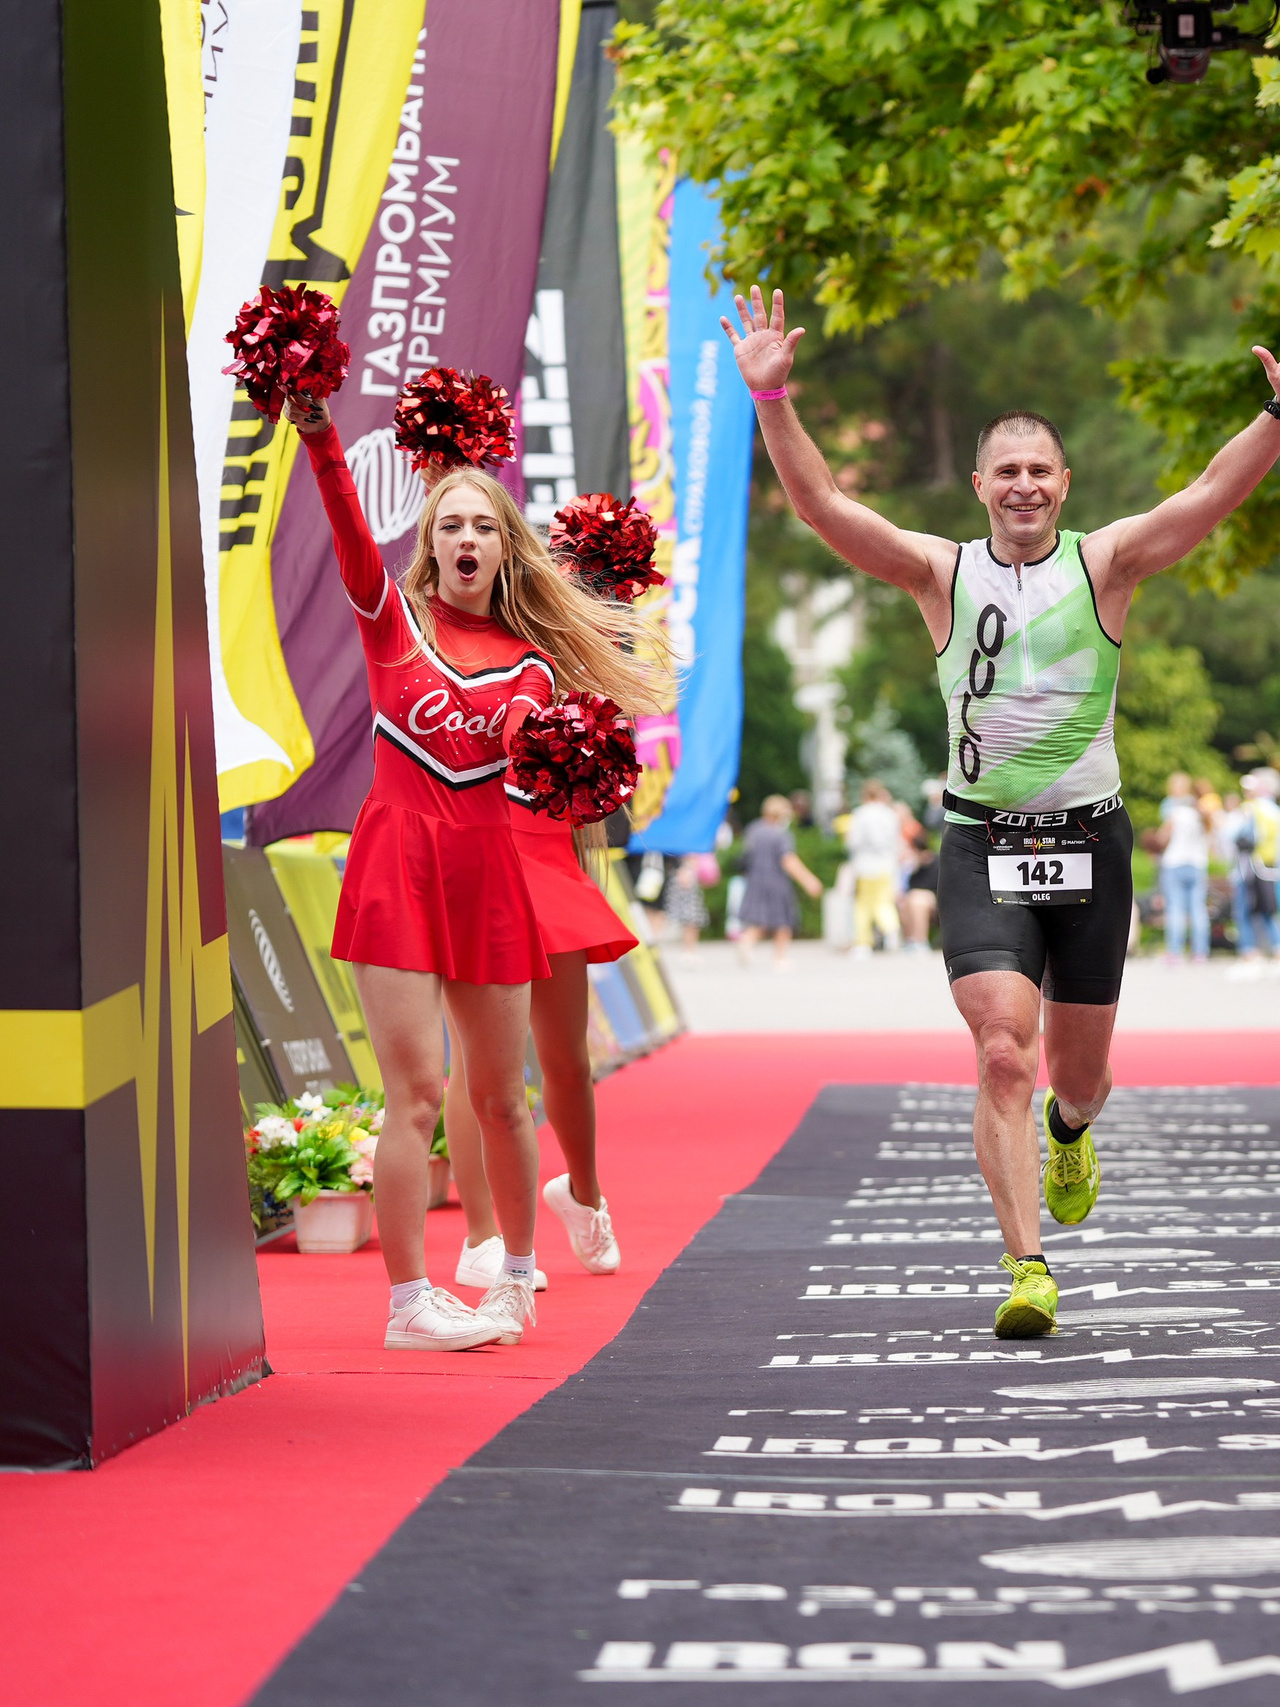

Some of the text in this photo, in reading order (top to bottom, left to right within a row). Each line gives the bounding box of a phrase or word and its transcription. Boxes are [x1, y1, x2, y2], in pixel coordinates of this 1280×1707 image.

[958, 603, 1008, 785] orca
[408, 689, 508, 738] Cool
[992, 809, 1068, 828] ZONE3
[1016, 860, 1064, 886] 142
[1031, 893, 1051, 901] OLEG
[768, 1350, 1042, 1366] IRON
[712, 1434, 1041, 1454] IRON
[677, 1487, 1042, 1511] IRON
[594, 1640, 1066, 1671] IRON
